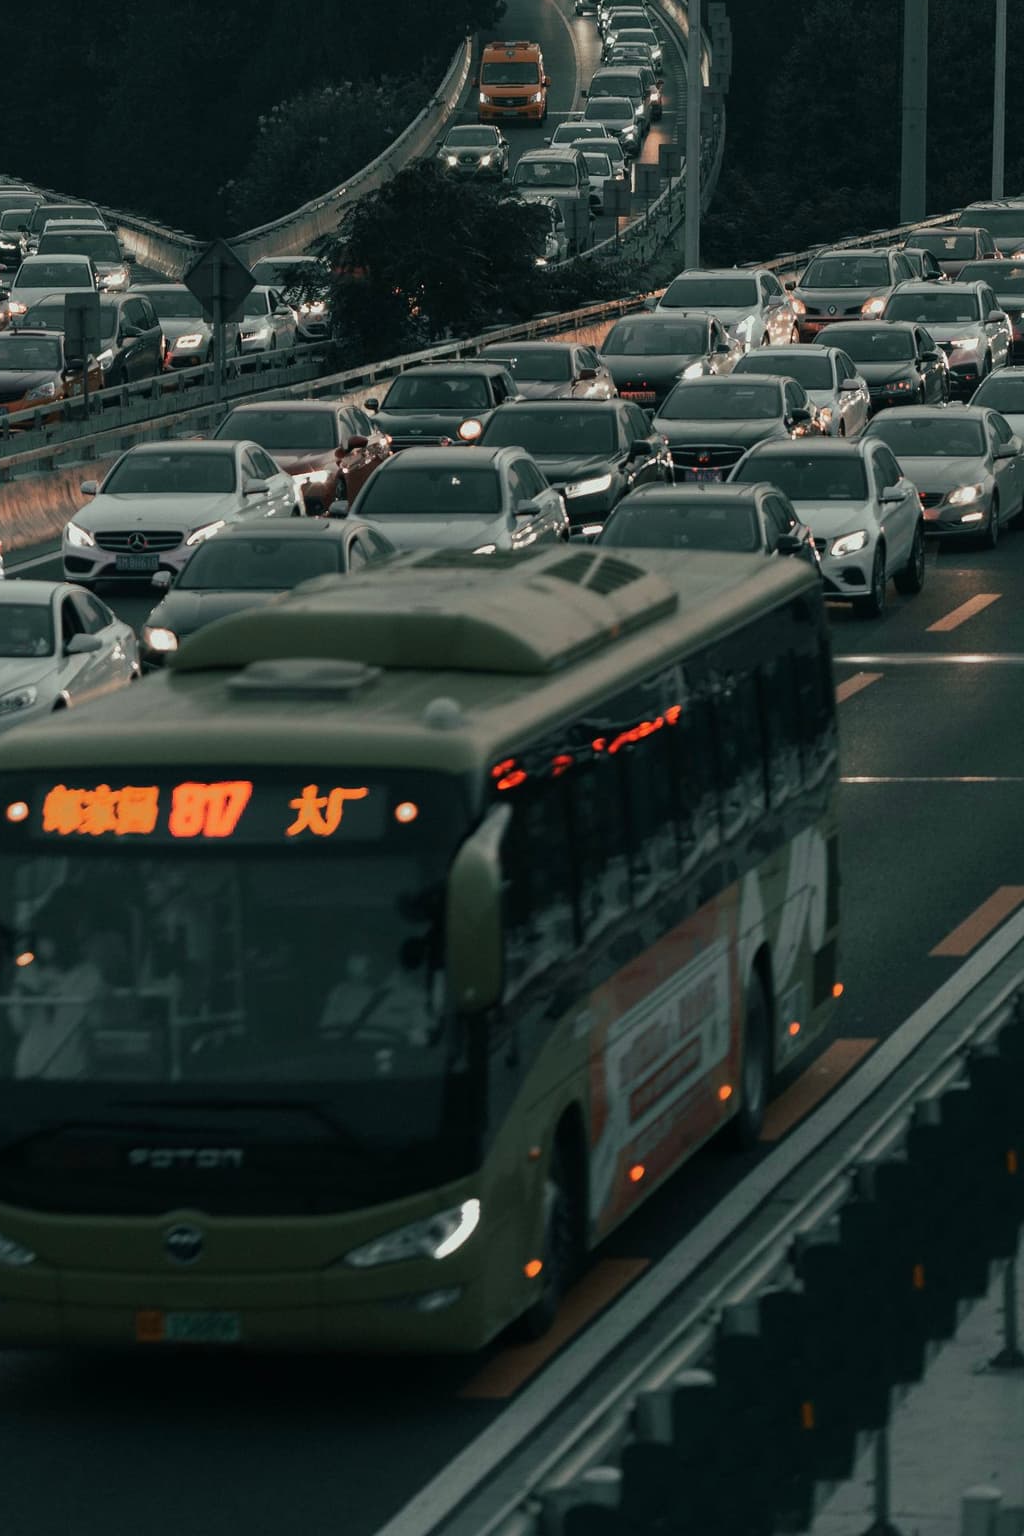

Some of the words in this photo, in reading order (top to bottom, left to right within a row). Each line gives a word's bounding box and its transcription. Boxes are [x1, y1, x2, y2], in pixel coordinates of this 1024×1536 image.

[169, 780, 253, 838] 817
[285, 784, 369, 837] 大厂
[129, 1148, 244, 1168] FOTON
